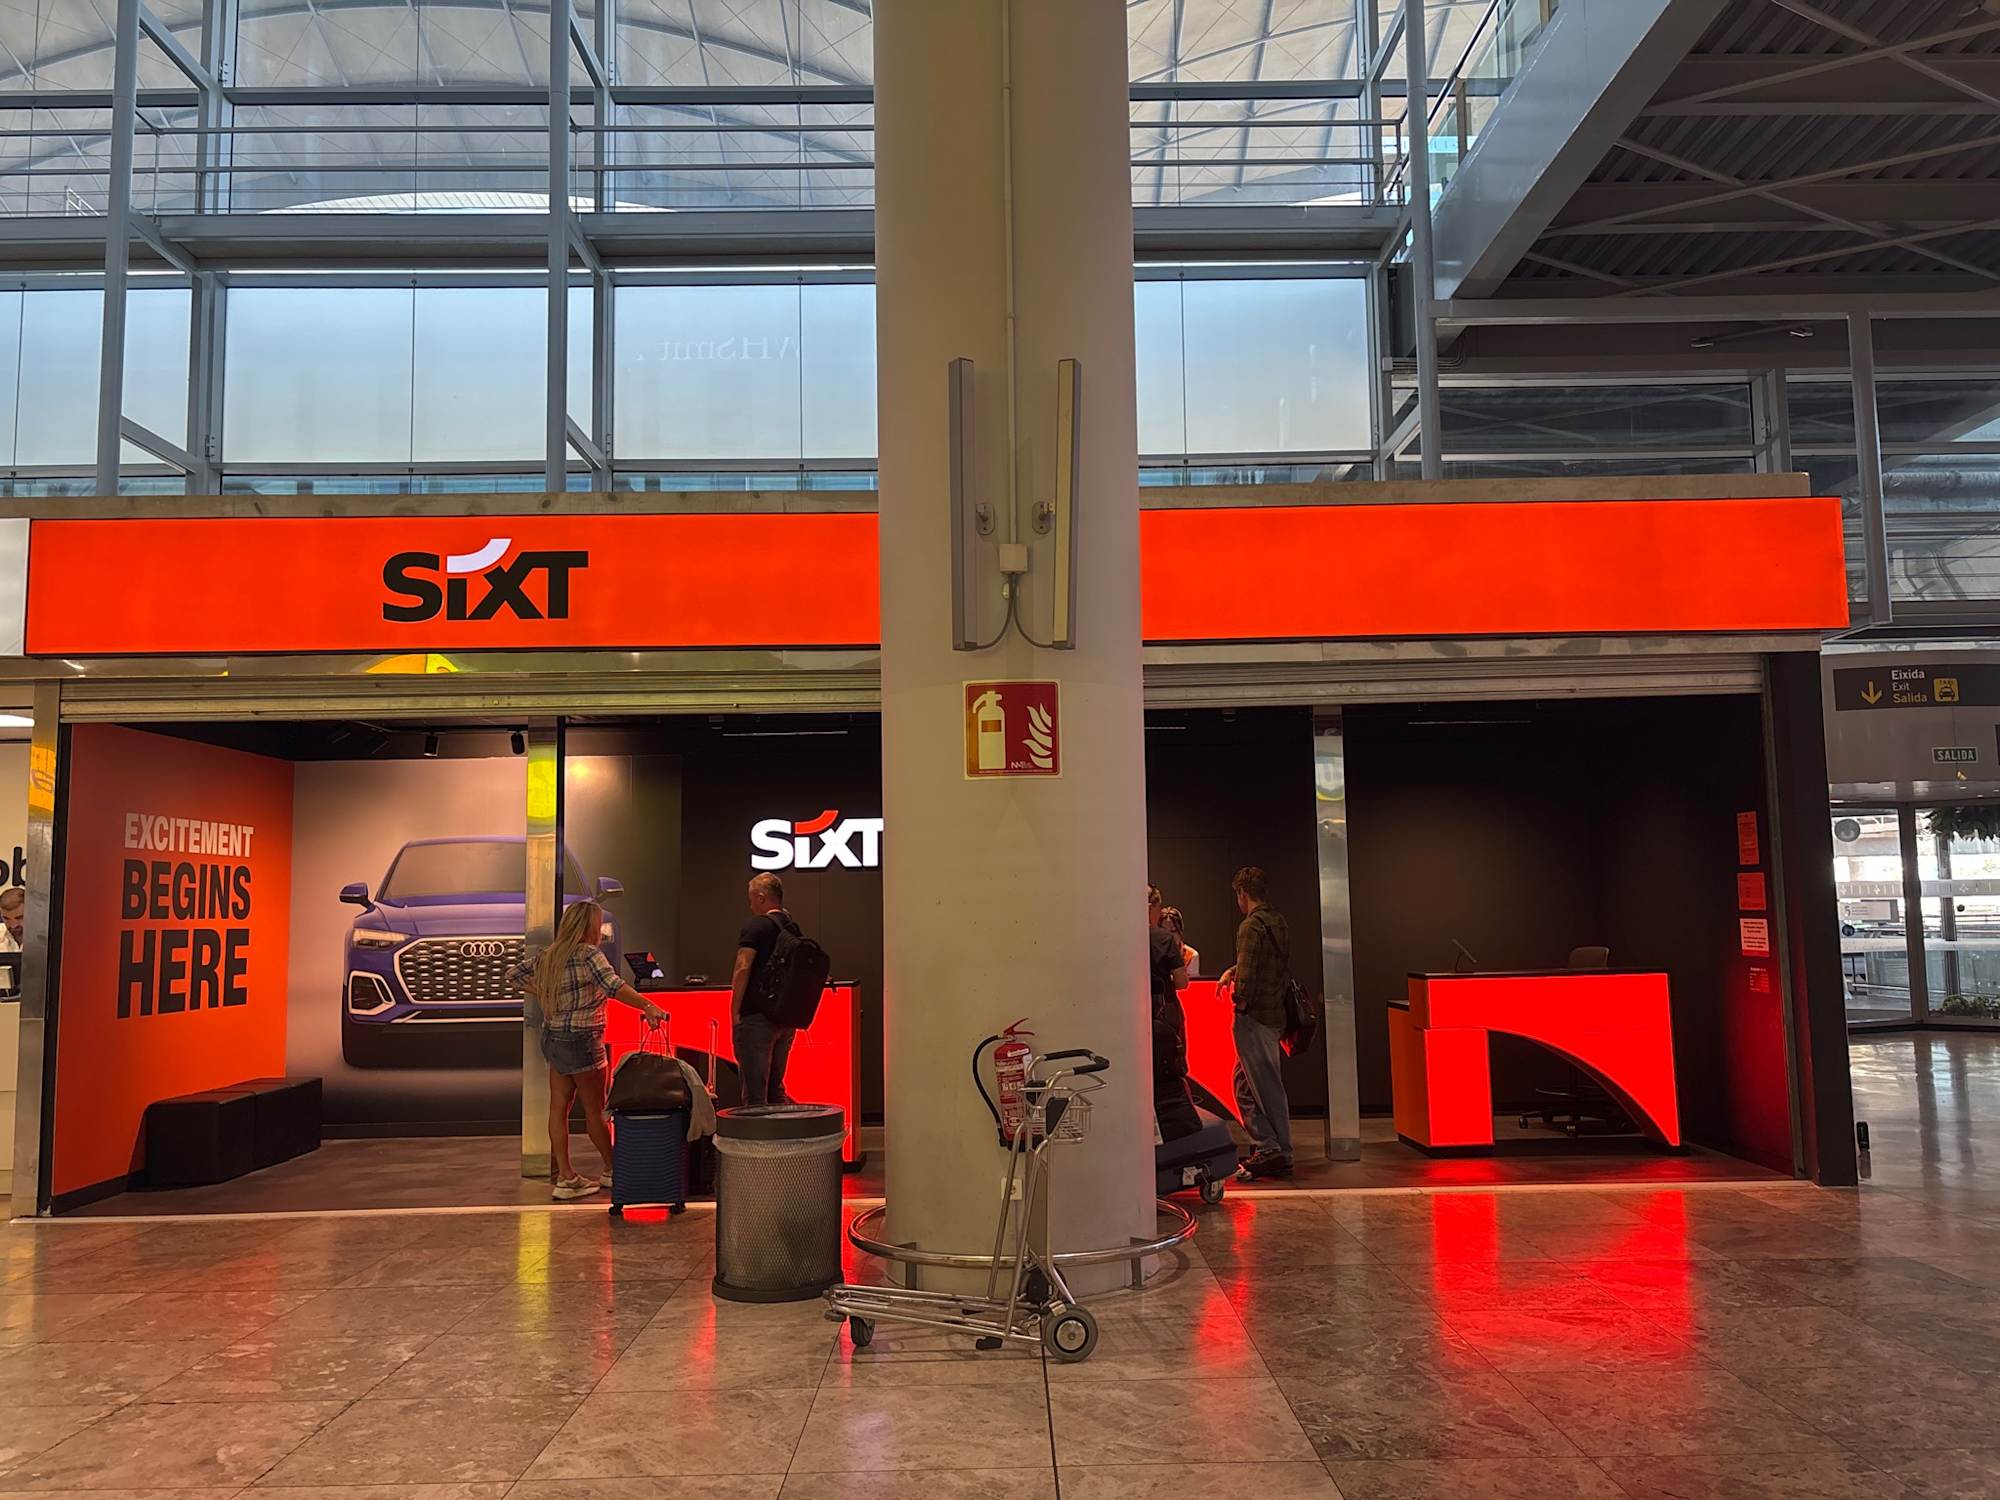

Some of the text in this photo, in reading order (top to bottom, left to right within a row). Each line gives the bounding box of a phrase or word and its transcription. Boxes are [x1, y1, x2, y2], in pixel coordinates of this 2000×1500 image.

[1891, 669, 1925, 680] Eixida
[1892, 682, 1910, 691] Exit
[1893, 692, 1928, 703] Salida
[1937, 749, 1975, 761] SALIDA
[124, 812, 254, 858] EXCITEMENT
[121, 858, 251, 921] BEGINS
[117, 928, 250, 1019] HERE
